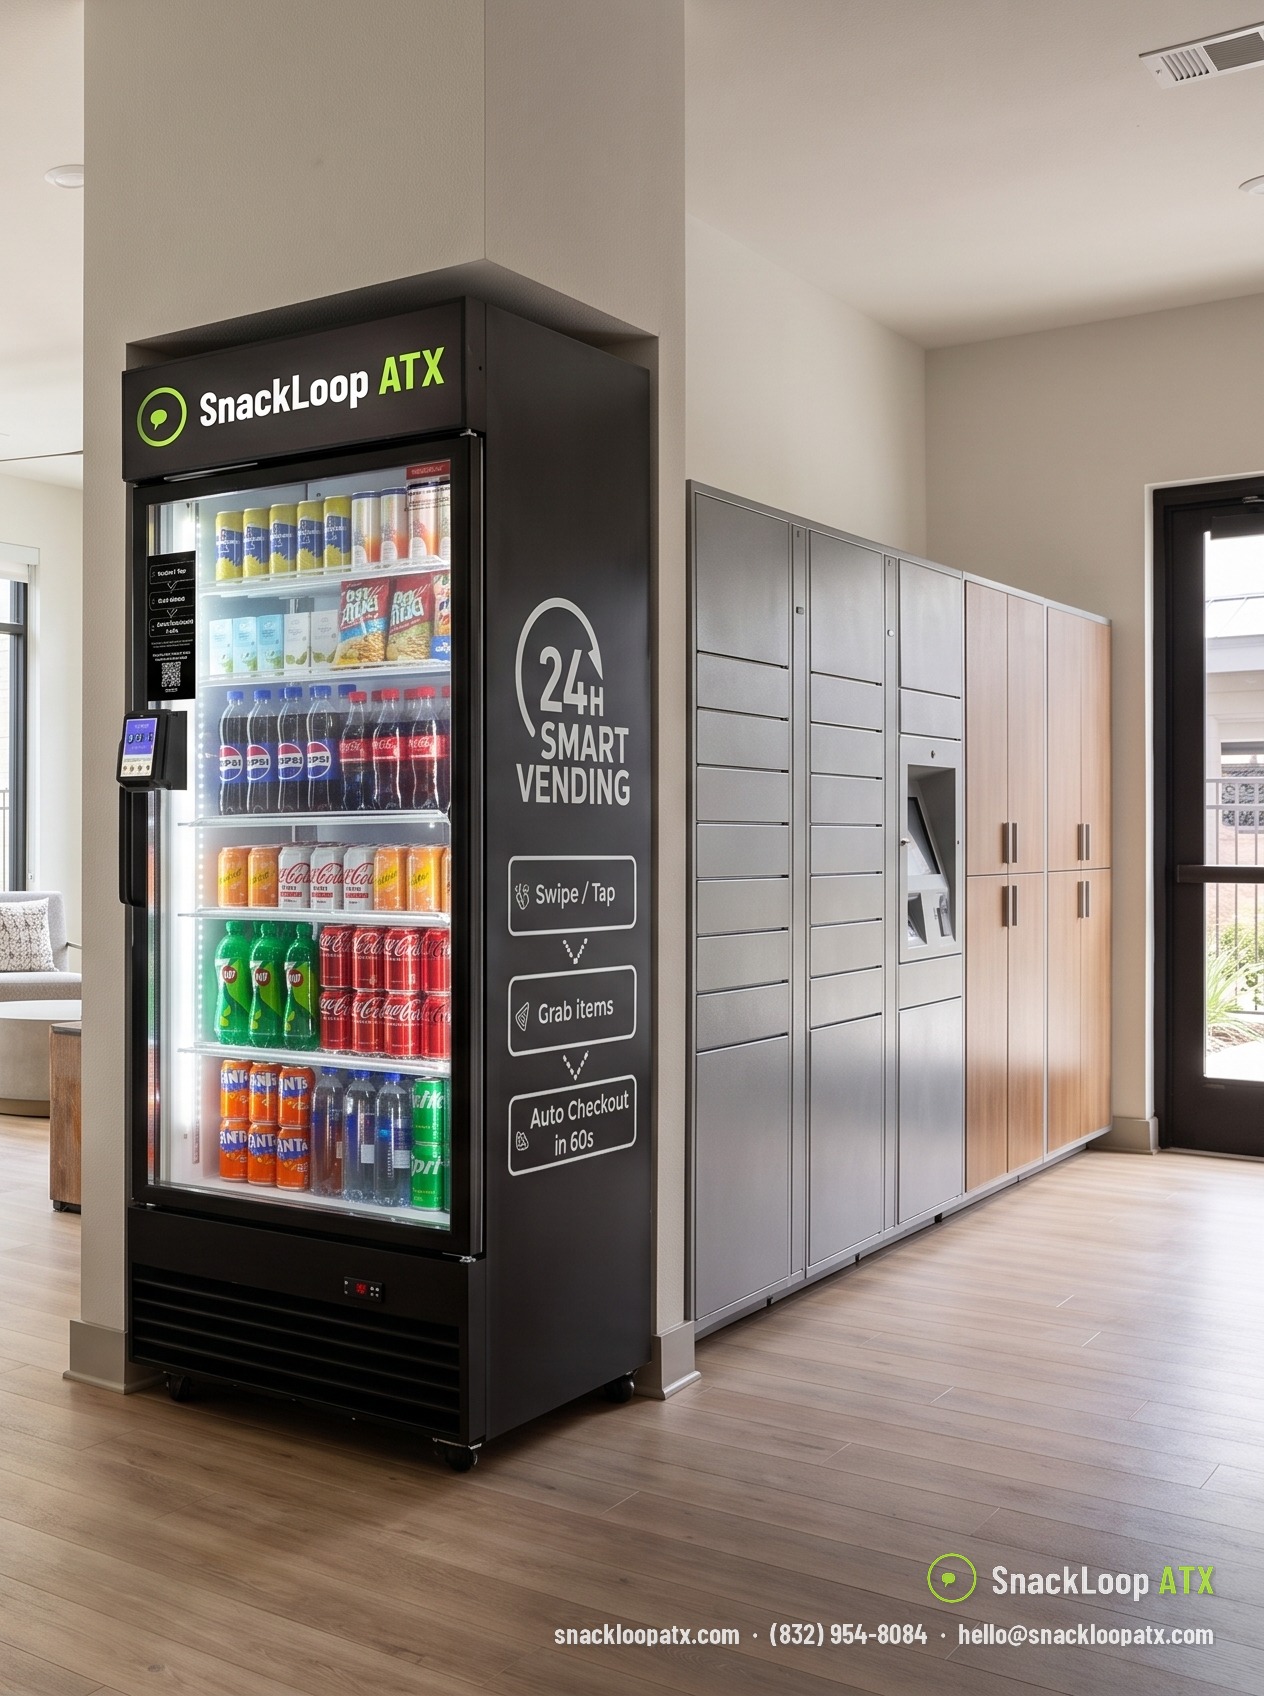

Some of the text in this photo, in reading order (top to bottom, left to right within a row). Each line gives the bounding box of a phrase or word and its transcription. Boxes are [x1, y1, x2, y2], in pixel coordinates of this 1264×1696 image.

[199, 346, 445, 427] SnackLoop ATX
[539, 645, 604, 717] 24H
[540, 720, 629, 764] SMART
[515, 763, 631, 807] VENDING
[535, 880, 616, 910] Swipe / Tap
[538, 998, 614, 1025] Grab items
[530, 1089, 630, 1130] Auto Checkout
[554, 1129, 594, 1156] in 60s
